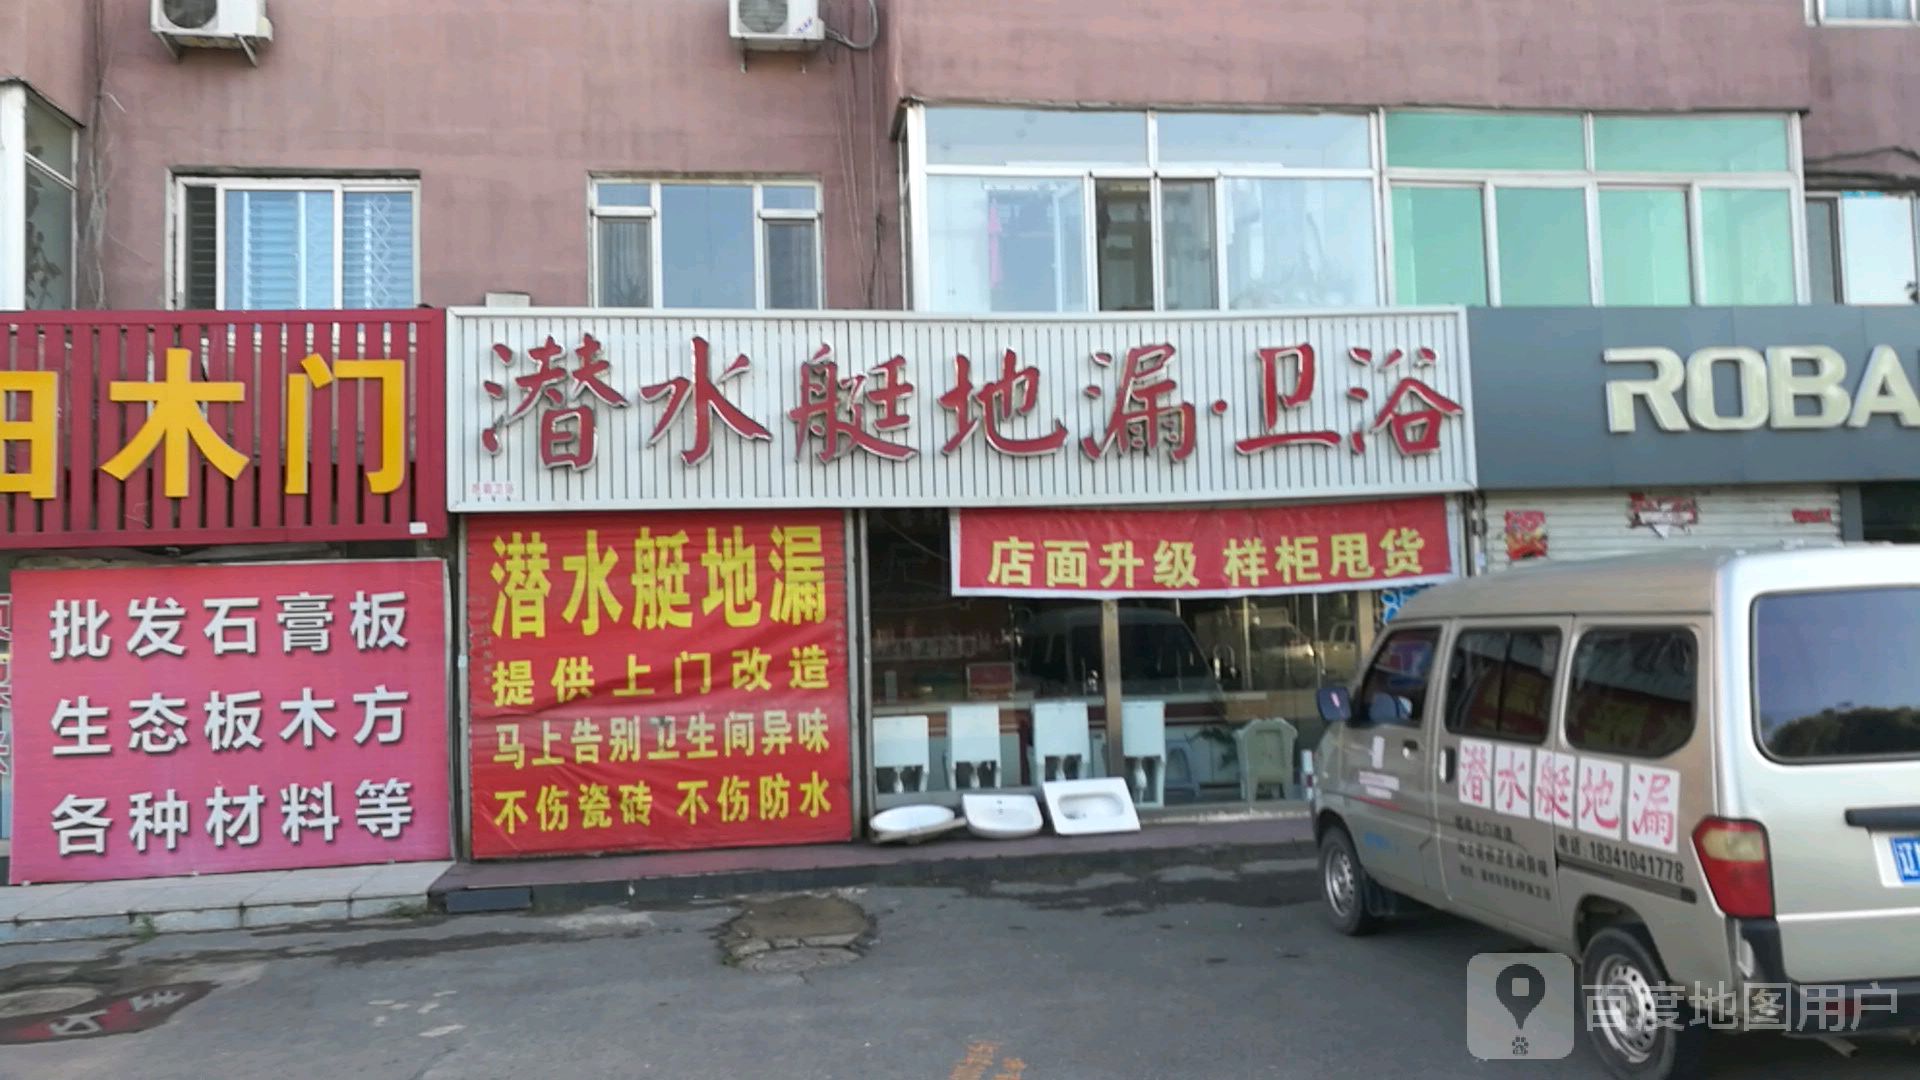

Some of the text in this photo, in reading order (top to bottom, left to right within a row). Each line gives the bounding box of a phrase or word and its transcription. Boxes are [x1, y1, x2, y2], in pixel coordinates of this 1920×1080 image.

[490, 526, 828, 640] 潜水艇地漏
[986, 527, 1426, 588] 店面升级 样柜甩货
[48, 591, 409, 661] 批发石膏板
[491, 644, 830, 707] 提供上门改造
[49, 685, 410, 757] 生态板木方
[493, 707, 831, 769] 马上告别卫生间异味
[50, 777, 413, 858] 各种材料等
[493, 771, 833, 835] 不伤瓷砖 不伤防水
[1462, 745, 1674, 845] 潜水艇地漏
[1590, 840, 1684, 883] 18341041778
